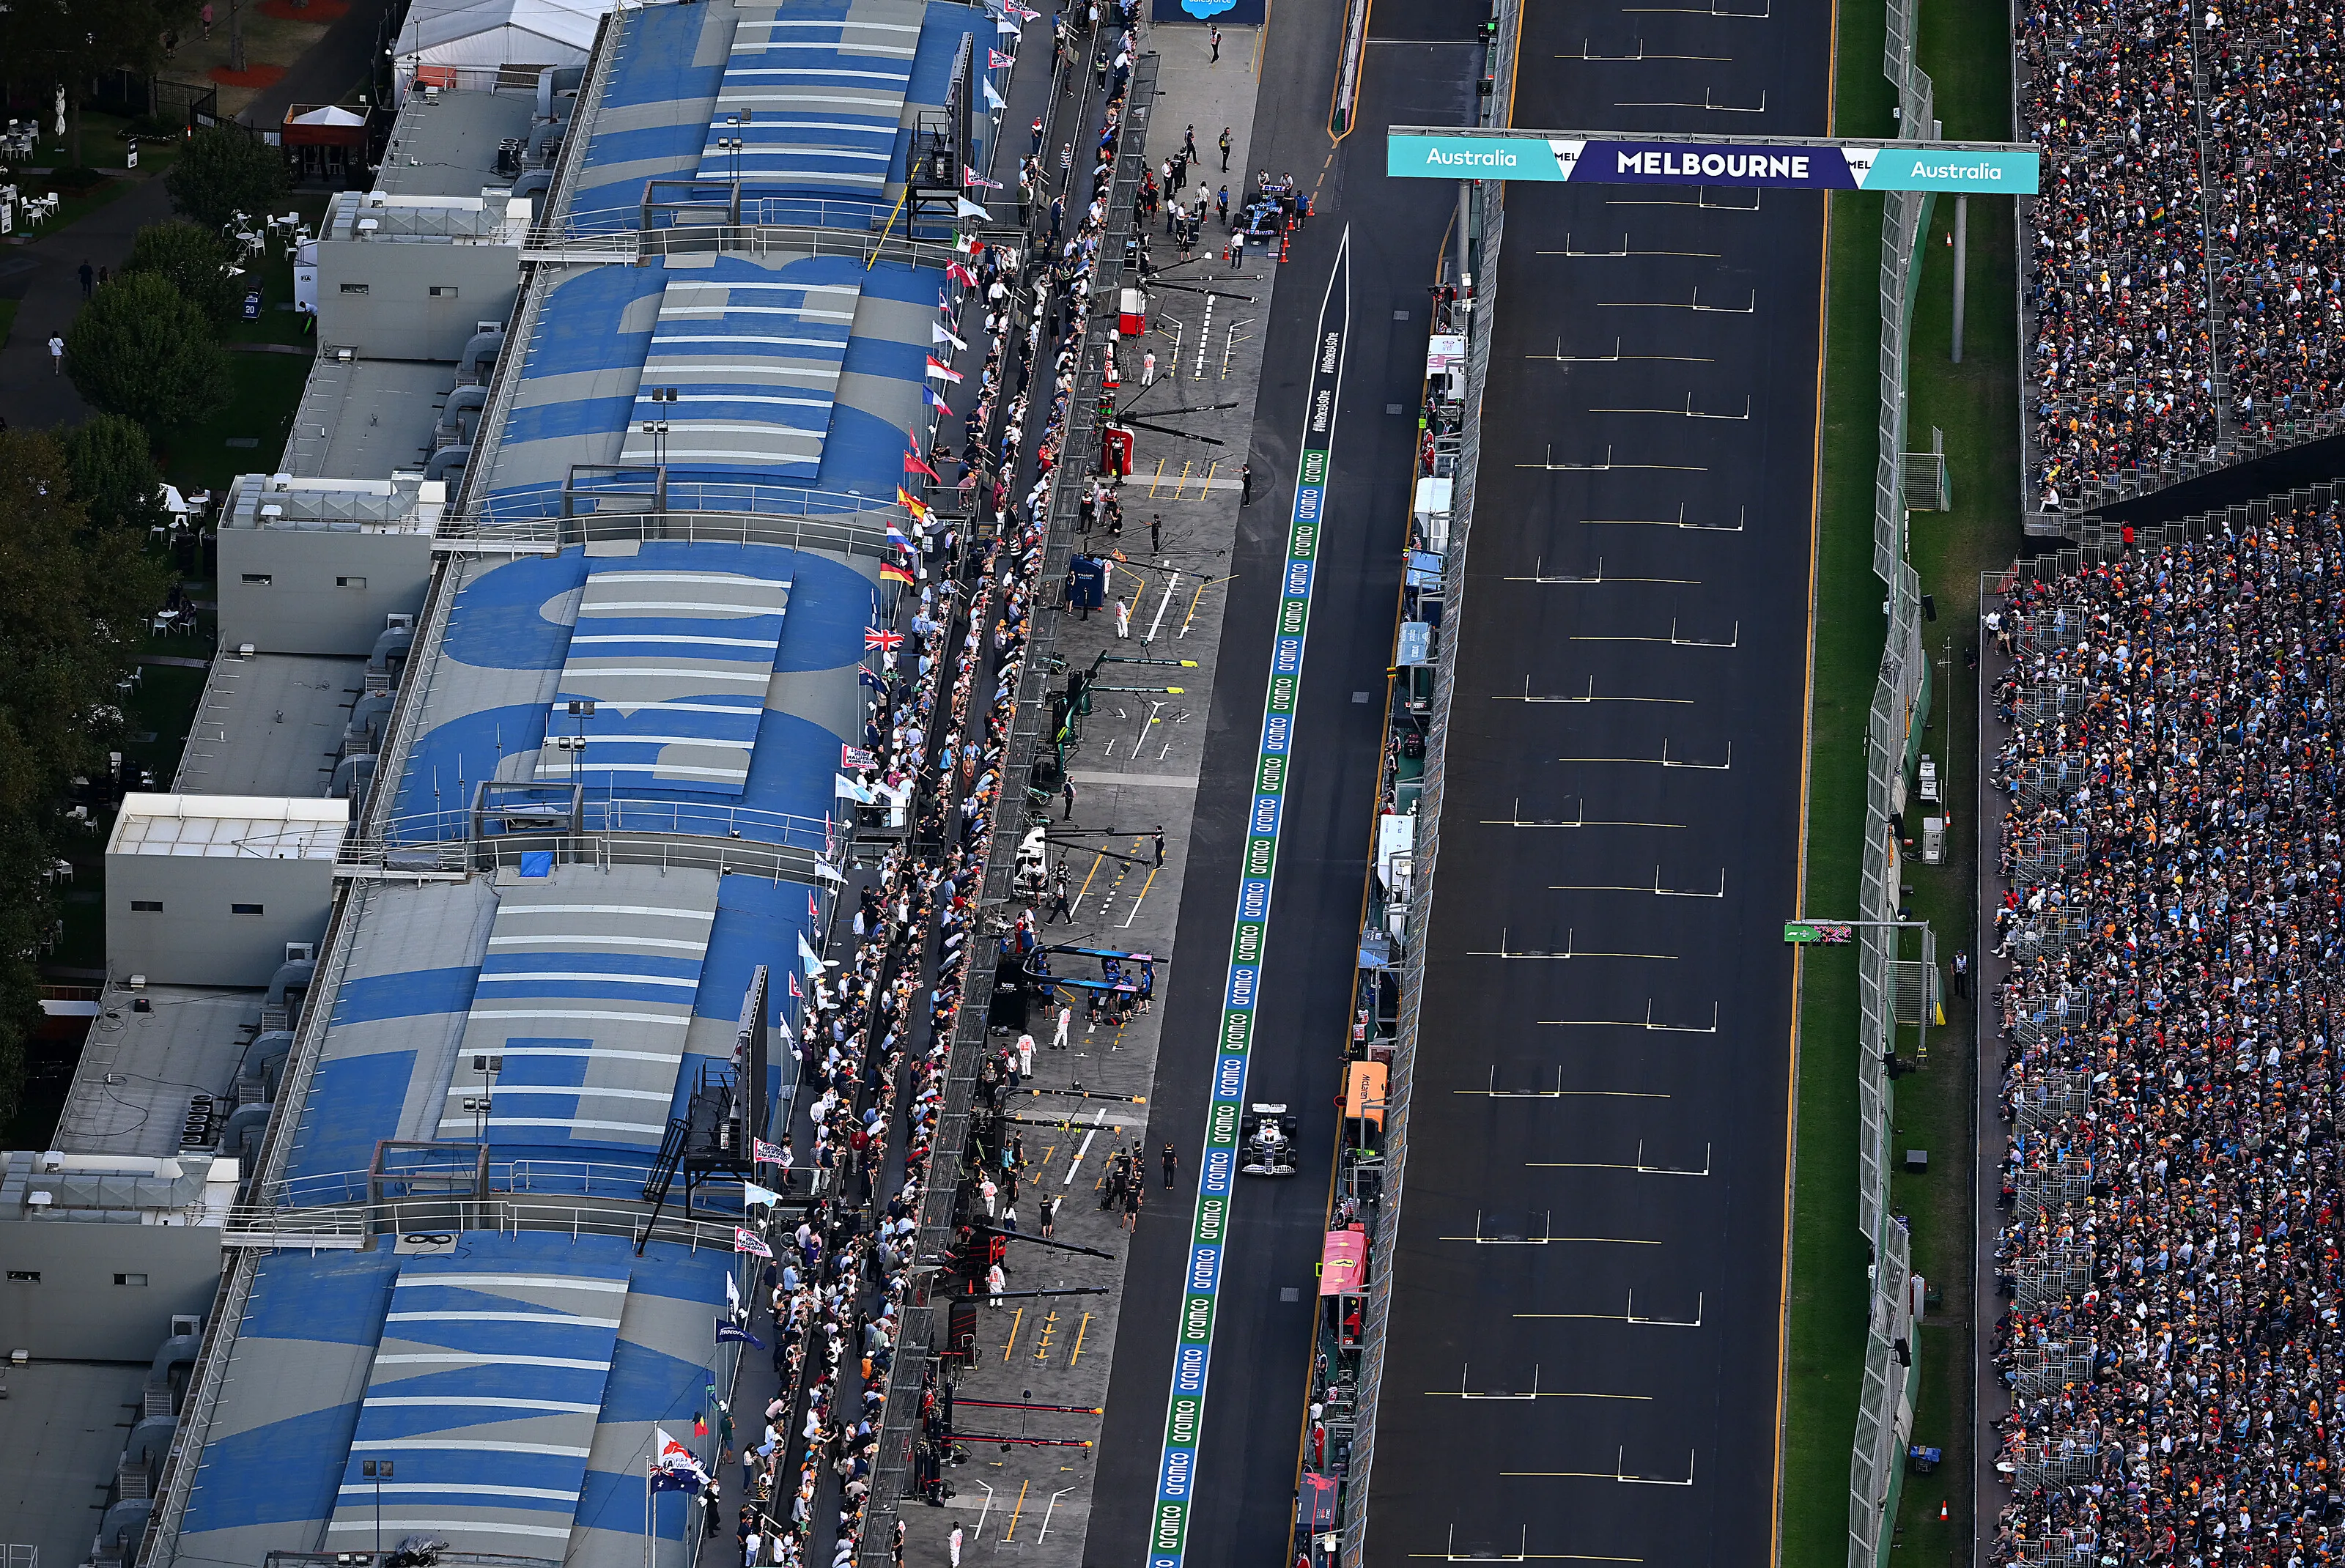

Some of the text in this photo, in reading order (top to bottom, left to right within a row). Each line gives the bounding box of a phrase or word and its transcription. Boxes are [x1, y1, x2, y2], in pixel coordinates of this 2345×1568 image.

[1426, 147, 1517, 167] Australia
[1554, 152, 1578, 161] MEL
[1617, 151, 1809, 179] MELBOURNE
[1848, 160, 1872, 169] MEL
[1911, 161, 2001, 180] Australia
[245, 306, 254, 314] 20
[1321, 332, 1340, 374] #WeRaceAsOne
[1312, 390, 1331, 432] #WeRaceAsOne
[1304, 454, 1323, 482] aramco
[1299, 489, 1318, 518] aramco
[1294, 526, 1313, 555] aramco
[1289, 564, 1308, 593] aramco
[1284, 602, 1303, 632] aramco
[1278, 640, 1298, 670] aramco
[1272, 678, 1292, 709] aramco
[1267, 718, 1287, 750] aramco
[1262, 758, 1282, 791] aramco
[1256, 799, 1276, 832] aramco
[1250, 840, 1270, 873] aramco
[1244, 883, 1265, 916] aramco
[1238, 925, 1259, 960] aramco
[1233, 969, 1253, 1005] aramco
[1226, 1014, 1247, 1049] aramco
[1220, 1059, 1241, 1095] aramco
[1360, 1074, 1370, 1100] McLaren
[1214, 1106, 1235, 1142] aramco
[1207, 1153, 1228, 1190] aramco
[1200, 1201, 1222, 1238] aramco
[1193, 1249, 1215, 1288] aramco
[1187, 1299, 1209, 1339] aramco
[1180, 1350, 1203, 1389] aramco
[1172, 1401, 1195, 1441] aramco
[1166, 1453, 1189, 1495] aramco
[1159, 1506, 1181, 1548] aramco
